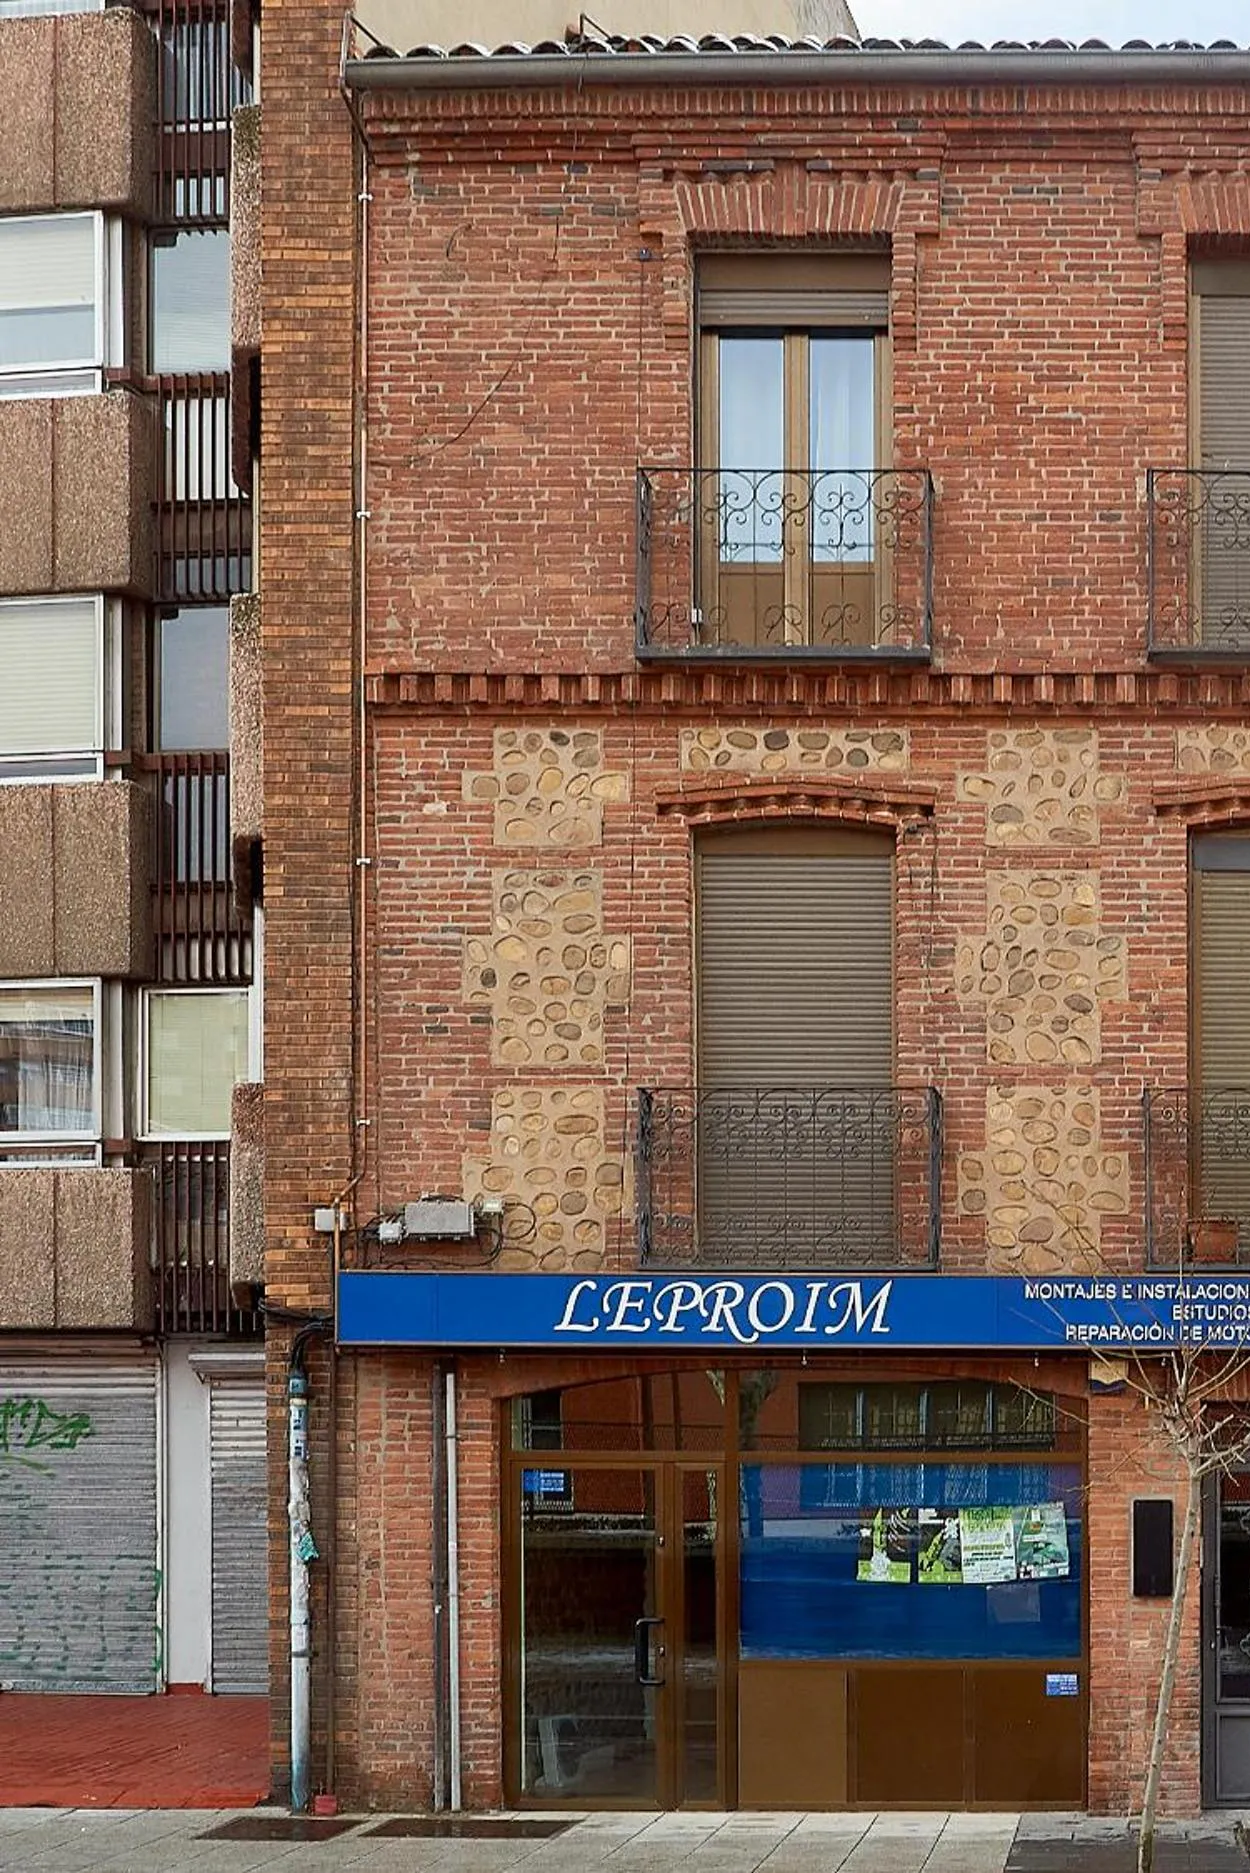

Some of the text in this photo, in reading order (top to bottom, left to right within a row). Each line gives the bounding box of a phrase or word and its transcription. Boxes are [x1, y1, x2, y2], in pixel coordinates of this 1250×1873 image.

[1025, 1283, 1116, 1299] MONTAJES
[1122, 1284, 1132, 1299] E
[553, 1280, 892, 1343] LEPROIM
[1066, 1322, 1174, 1341] REPARACIÓN
[1180, 1325, 1202, 1341] DE
